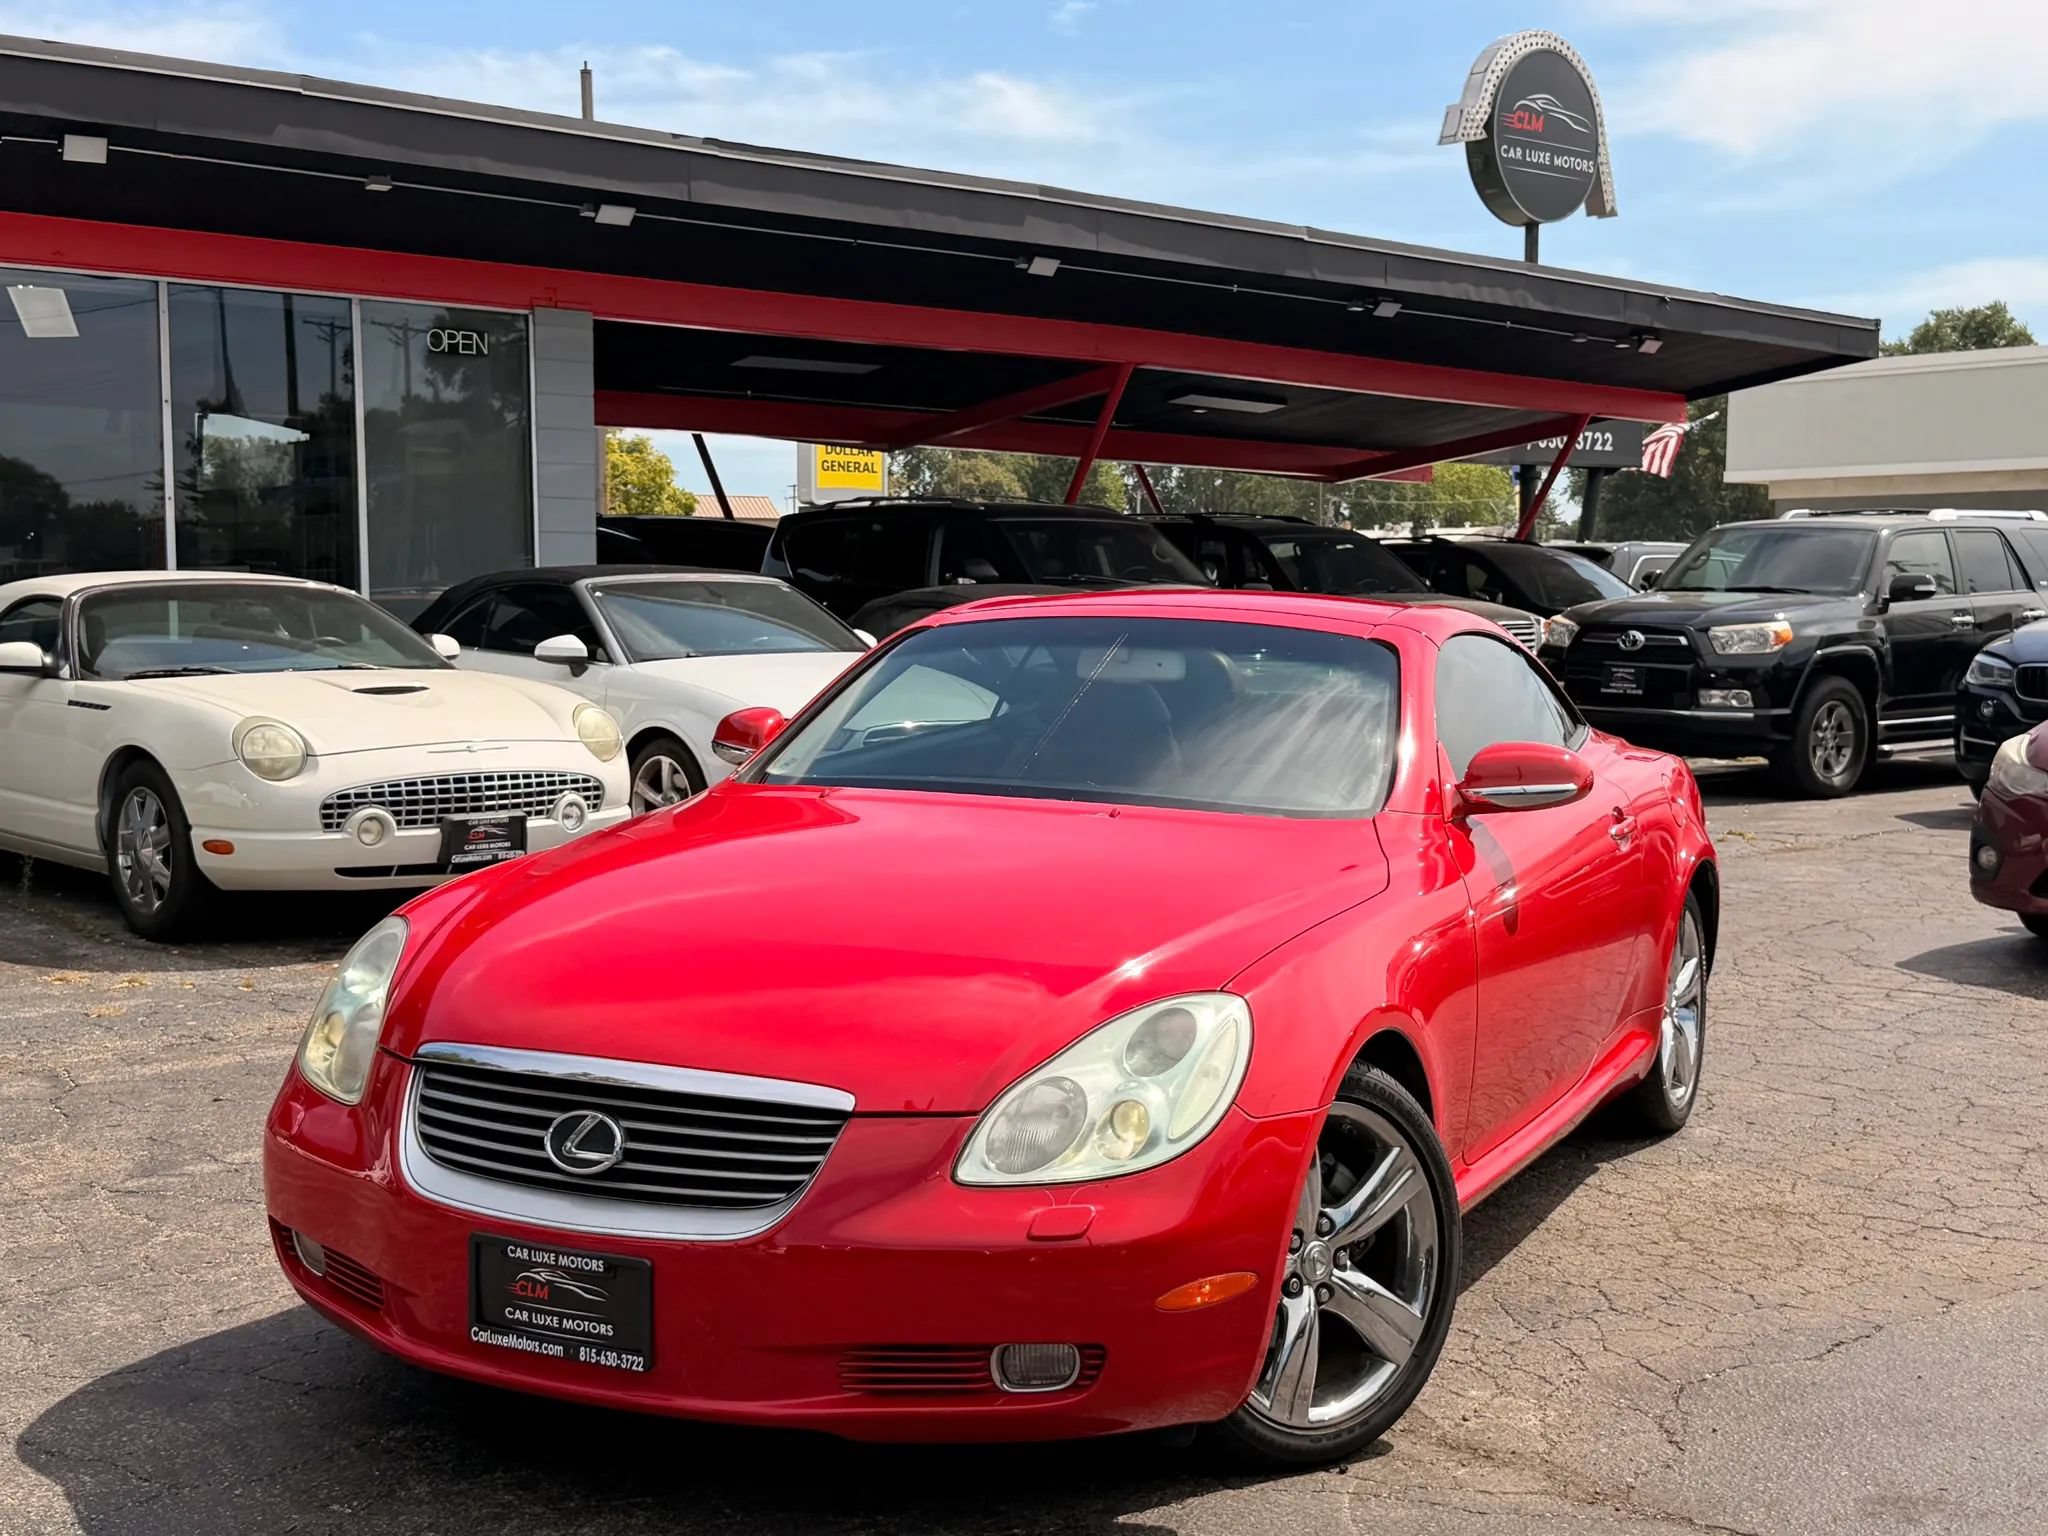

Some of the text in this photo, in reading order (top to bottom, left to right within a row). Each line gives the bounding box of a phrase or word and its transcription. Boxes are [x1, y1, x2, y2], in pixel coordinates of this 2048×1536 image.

[1512, 110, 1545, 133] CLM
[1500, 144, 1594, 173] CAR LUXE MOTORS
[426, 328, 488, 355] OPEN
[821, 459, 878, 474] GENERAL
[507, 1245, 604, 1272] CAR LUXE MOTORS
[515, 1280, 549, 1299] CLM
[504, 1307, 614, 1336] CAR LUXE MOTORS
[470, 1326, 645, 1372] CarLuxeMotors.com 815-630-3722
